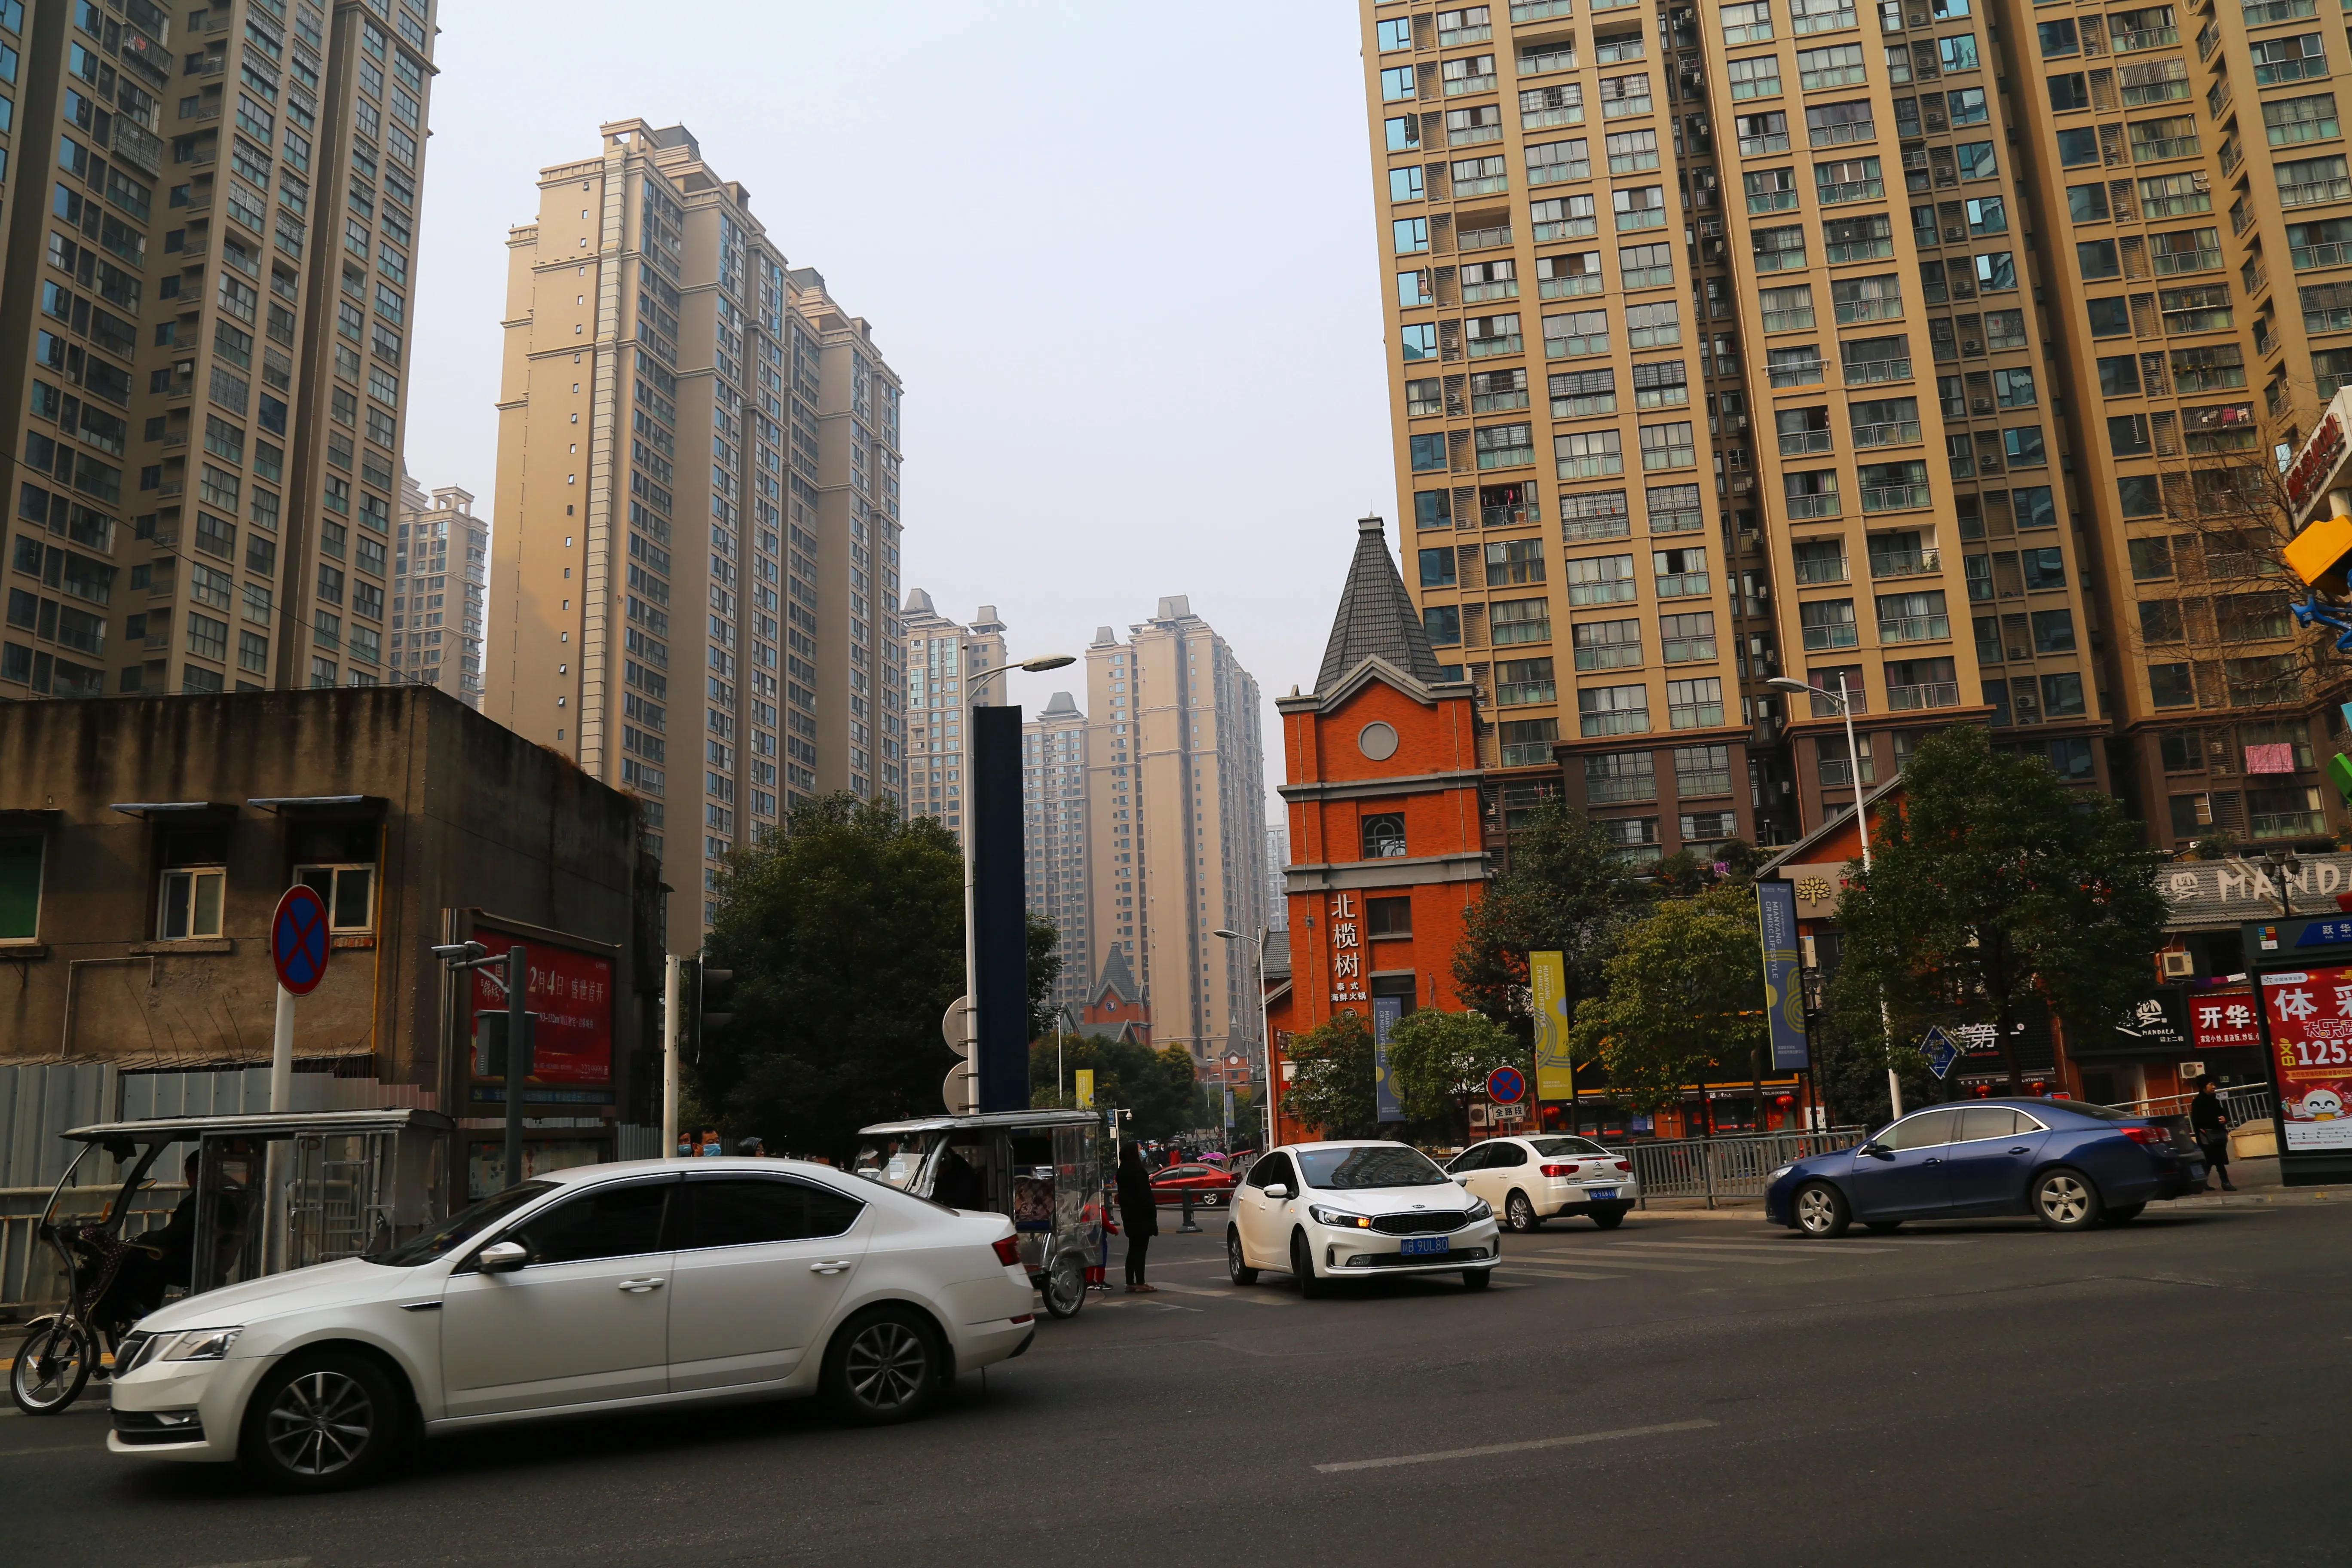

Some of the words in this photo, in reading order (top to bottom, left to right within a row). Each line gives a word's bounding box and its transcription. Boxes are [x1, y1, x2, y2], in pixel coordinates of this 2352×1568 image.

[2217, 862, 2352, 902] MAND
[1331, 894, 1359, 978] 北榄树
[1765, 901, 1772, 912] CR
[1769, 935, 1778, 978] LIFESTYLE
[1772, 901, 1782, 944] MIANYANG
[528, 966, 564, 996] 2月4日
[571, 978, 604, 1004] 盛世首开
[1336, 981, 1359, 992] 泰式
[1537, 965, 1542, 974] CR
[1543, 965, 1551, 1000] MIANYANG
[1331, 992, 1367, 1002] 海鲜火锅
[2199, 1004, 2258, 1029] 开华
[1495, 1106, 1523, 1118] 全路段
